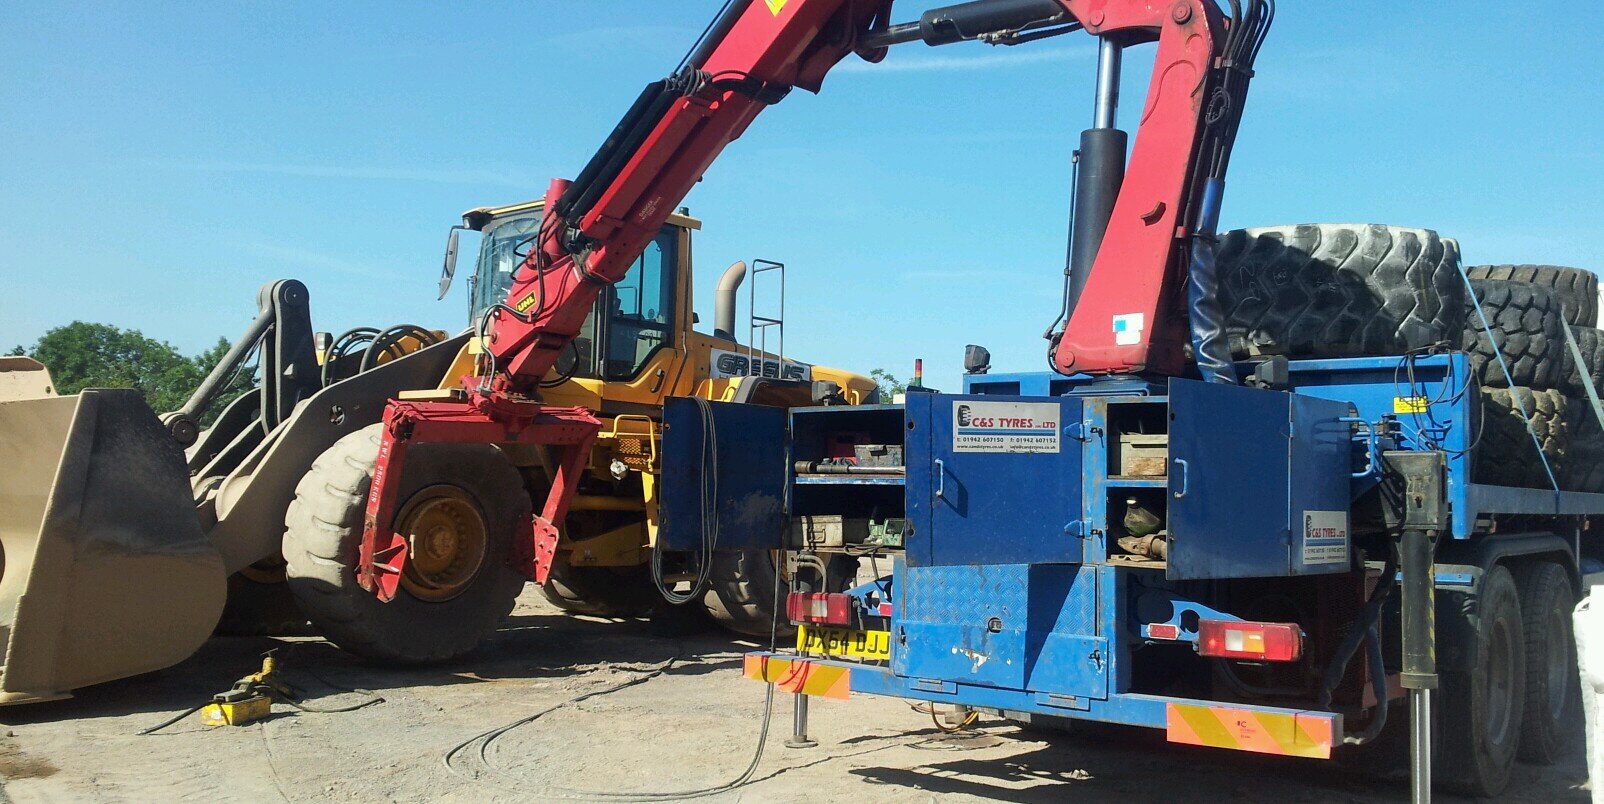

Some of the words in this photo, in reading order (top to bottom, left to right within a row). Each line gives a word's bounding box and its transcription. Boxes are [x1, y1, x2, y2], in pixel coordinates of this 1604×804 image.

[517, 296, 535, 312] UNL
[972, 418, 994, 427] C&S
[999, 418, 1033, 428] TYRES
[1312, 528, 1321, 537] C&S
[805, 630, 850, 652] DX54
[855, 632, 889, 654] DJJ
